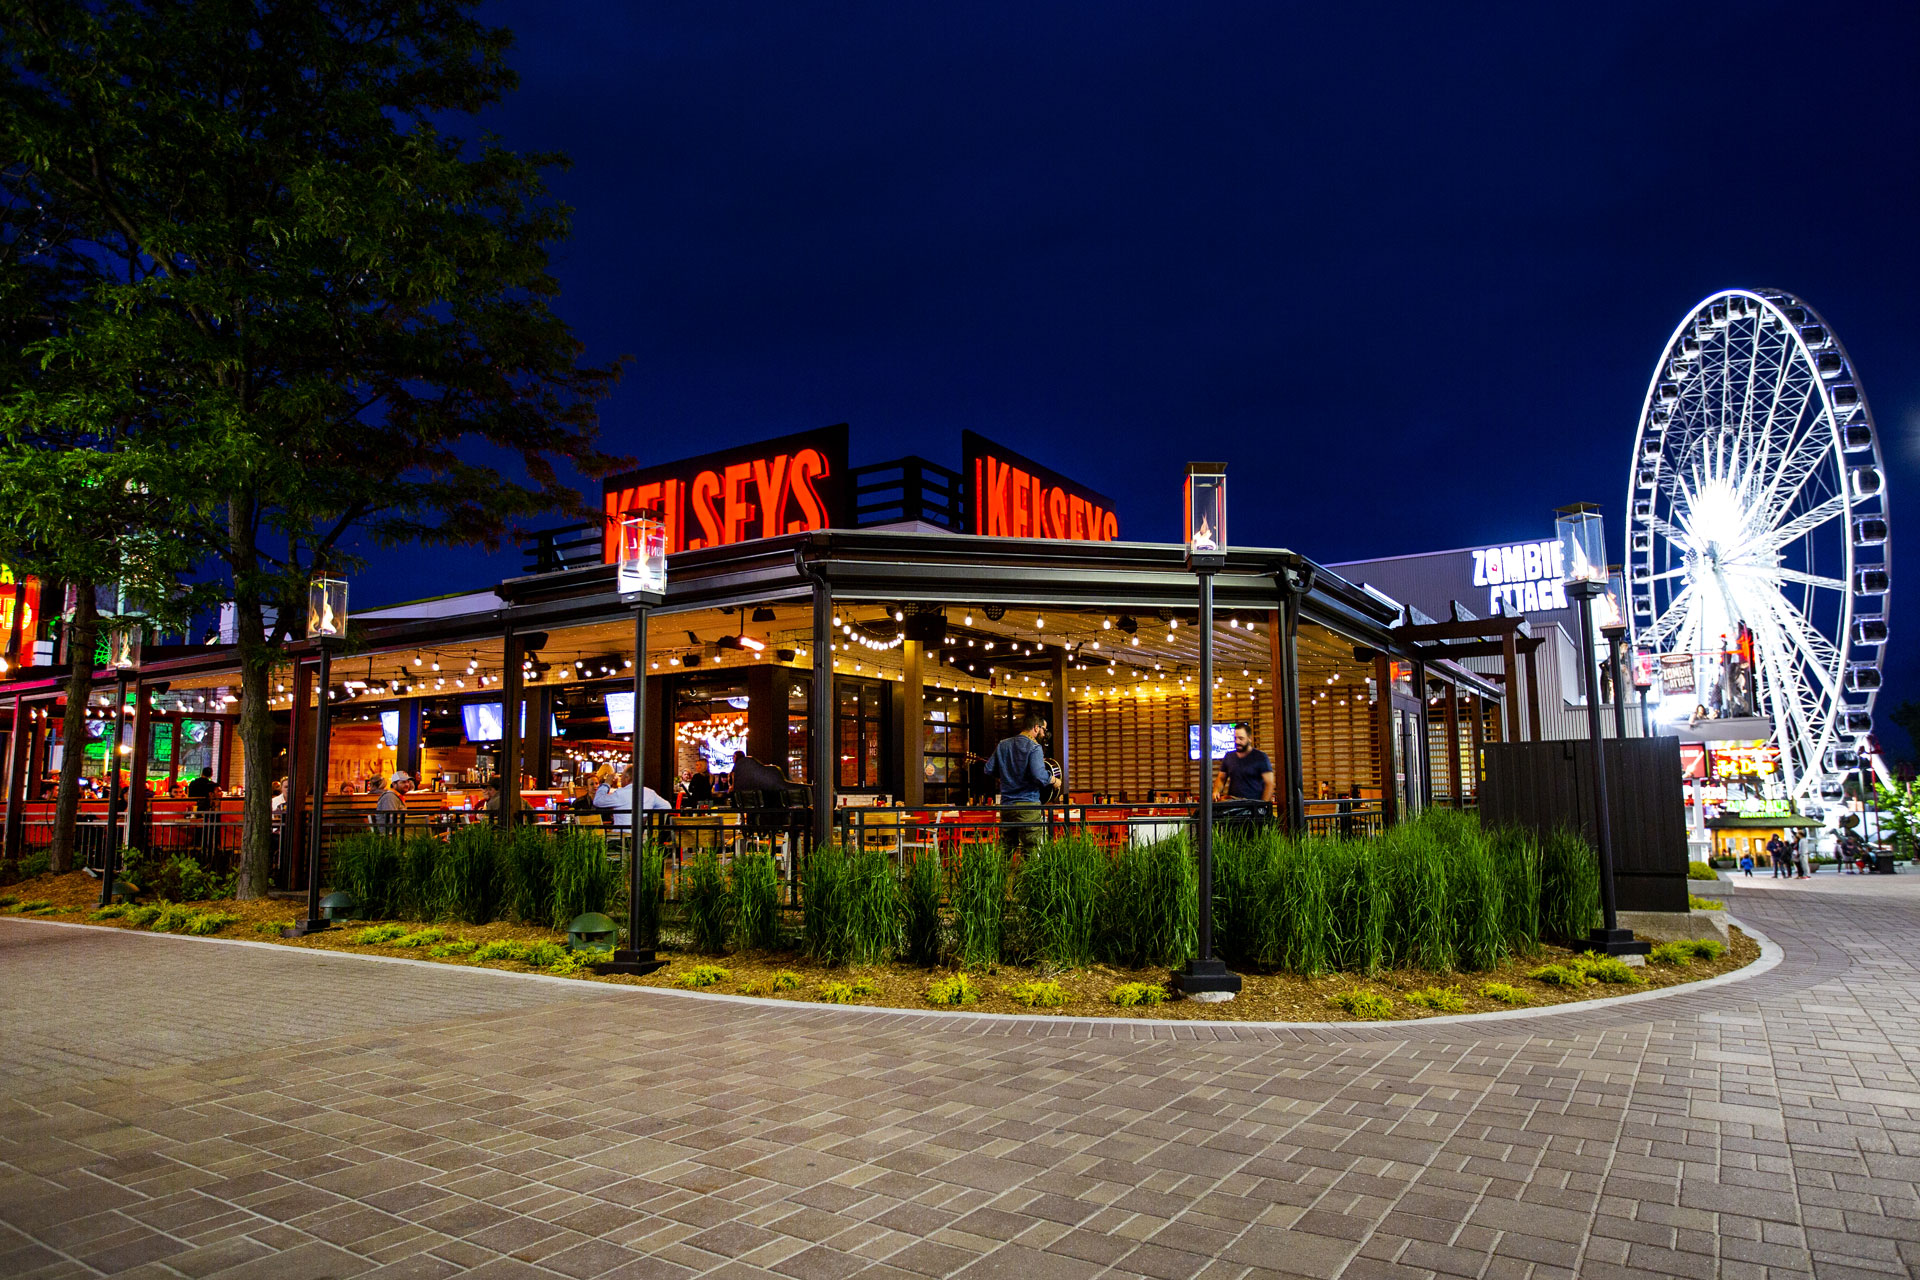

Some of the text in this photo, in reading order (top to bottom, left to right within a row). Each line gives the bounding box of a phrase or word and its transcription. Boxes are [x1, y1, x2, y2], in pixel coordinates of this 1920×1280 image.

[605, 448, 831, 565] KELSEYS
[1472, 540, 1565, 587] ZOMBIE
[1490, 578, 1569, 616] ATTACK
[1662, 665, 1692, 681] ZOMBIE
[1669, 676, 1695, 689] ATTACK
